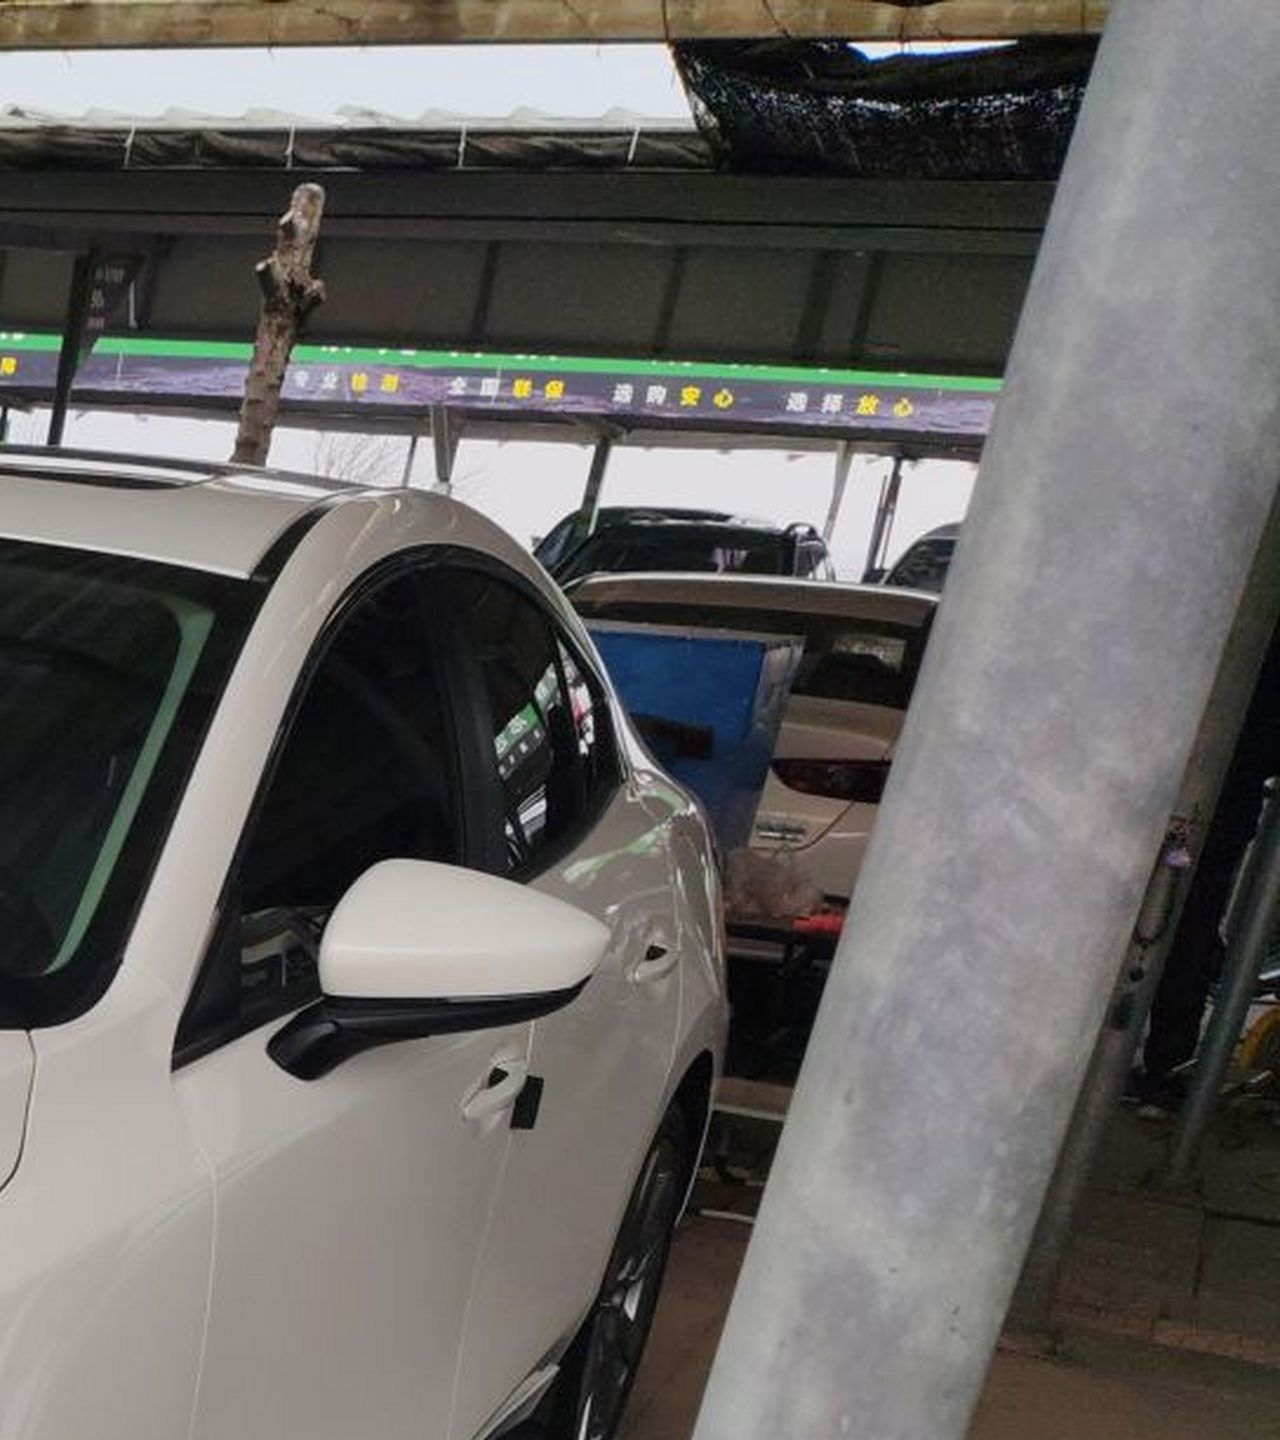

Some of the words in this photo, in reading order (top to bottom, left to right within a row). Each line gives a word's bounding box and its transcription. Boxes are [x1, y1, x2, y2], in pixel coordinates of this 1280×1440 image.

[612, 383, 735, 408] 选购安心
[786, 392, 914, 417] 选择放心
